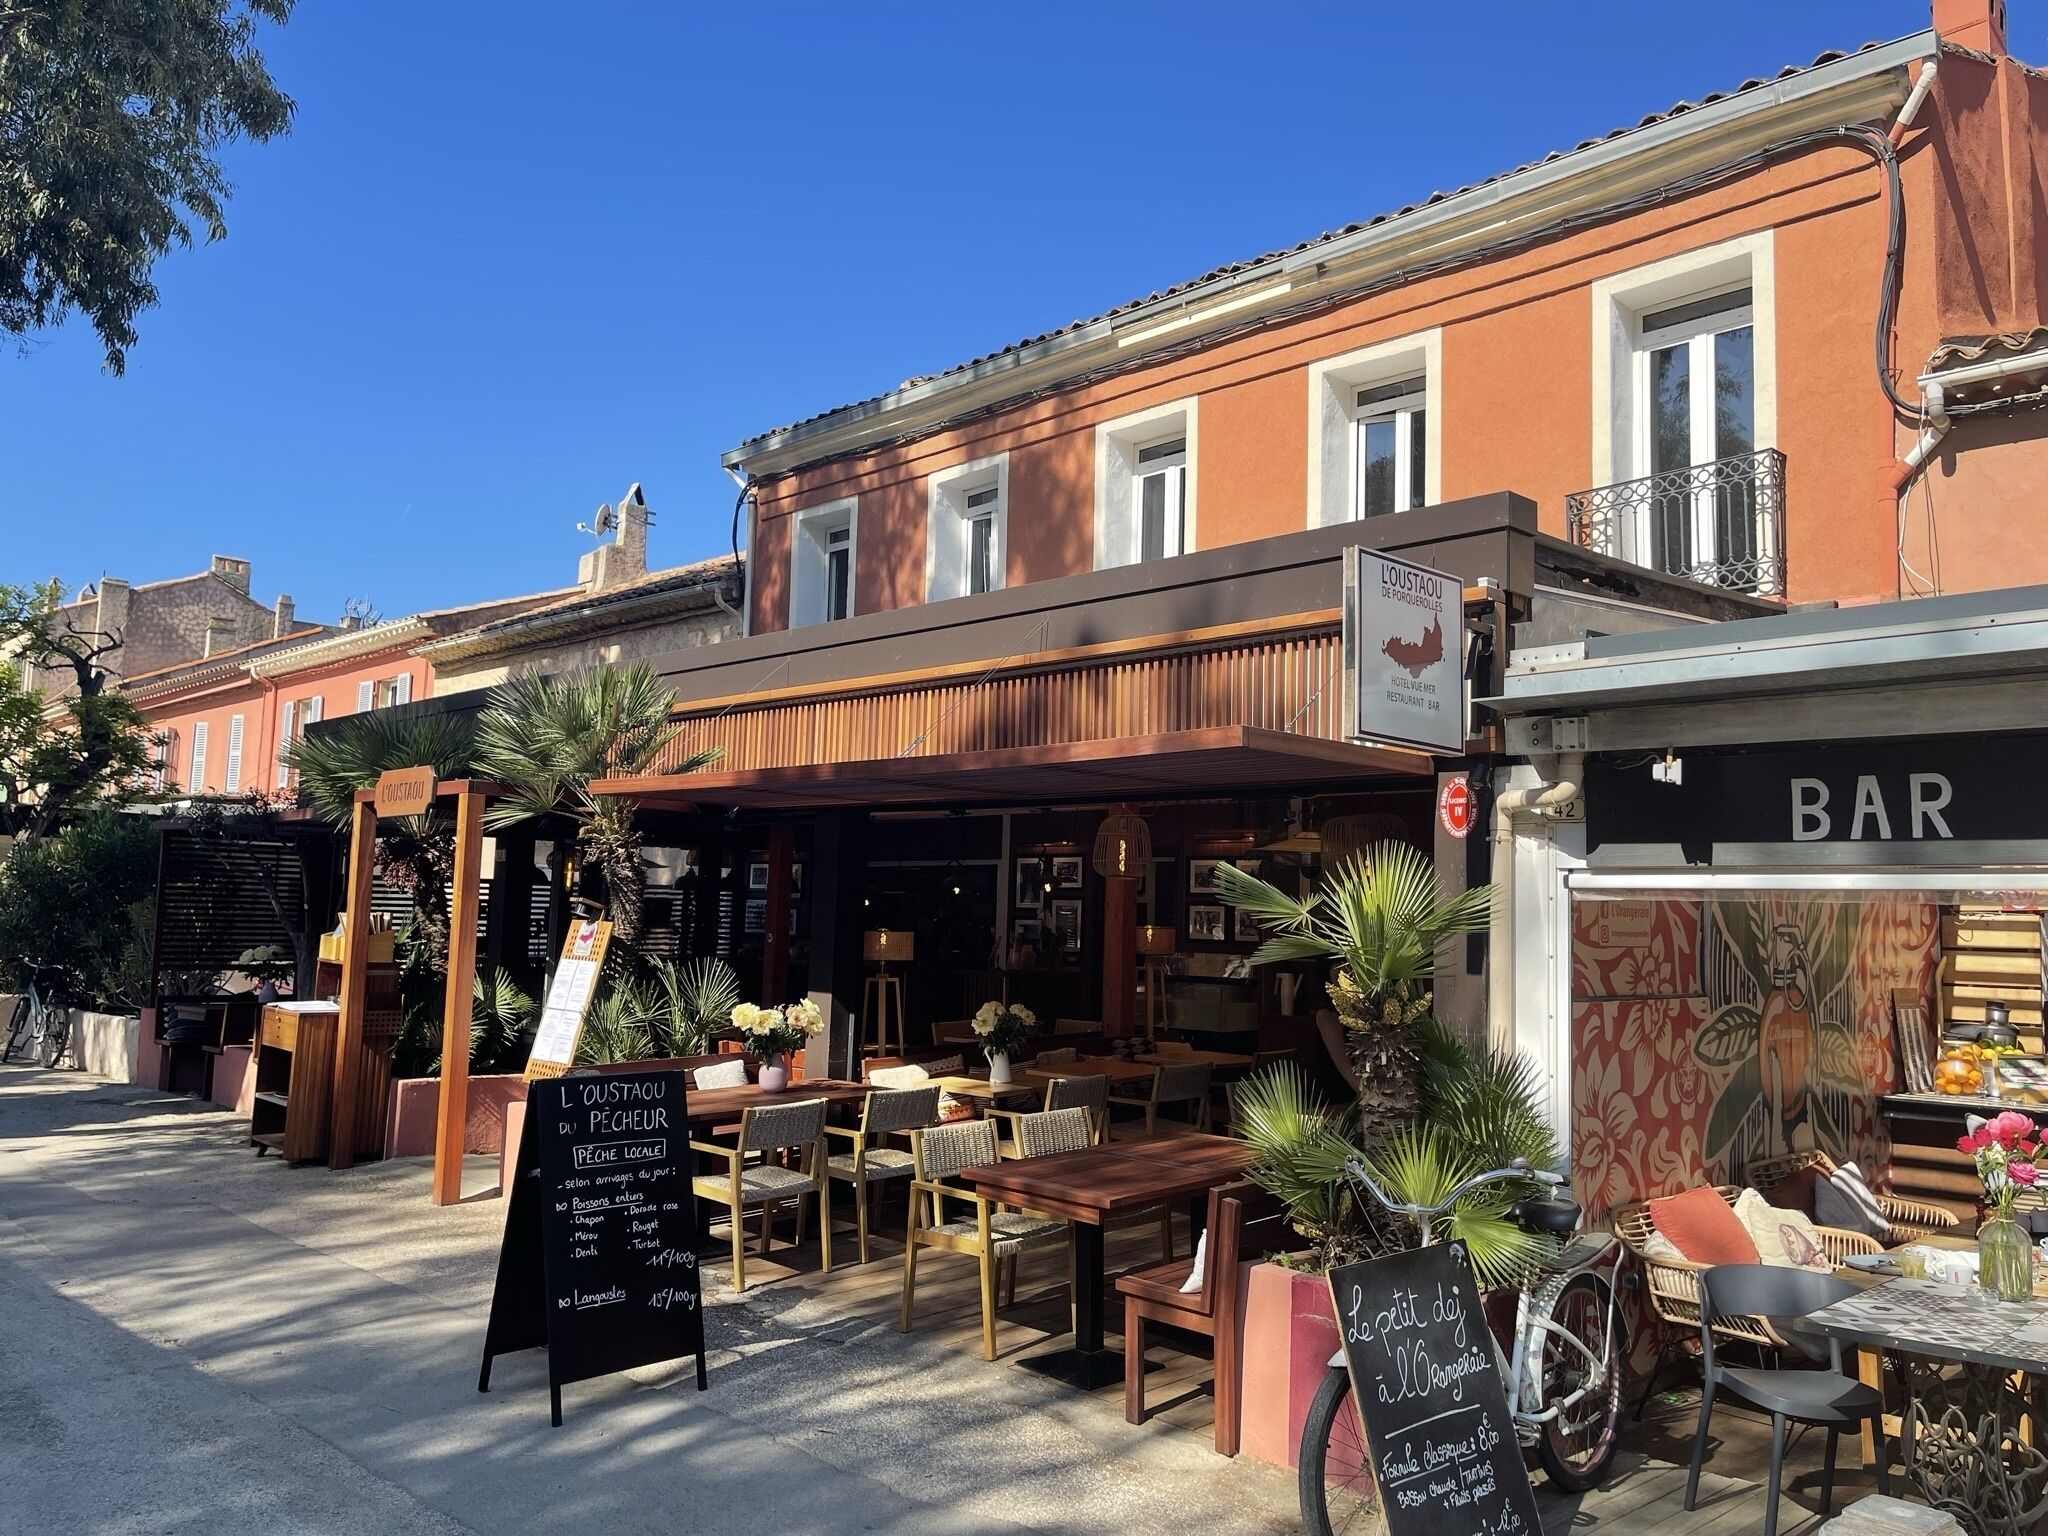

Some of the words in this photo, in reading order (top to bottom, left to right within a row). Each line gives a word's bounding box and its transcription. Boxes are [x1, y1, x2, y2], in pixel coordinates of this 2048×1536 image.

[1382, 563, 1442, 599] L'OUSTAOU
[1382, 586, 1391, 598] DE
[1393, 589, 1443, 612] PORQUEROLLES
[1391, 676, 1410, 689] HOTEL
[1411, 681, 1422, 692] VUE
[1424, 683, 1436, 694] MER
[1386, 690, 1424, 708] RESTAURANT
[1428, 700, 1440, 711] BAR
[381, 780, 425, 804] L'OUSTAOU
[1454, 806, 1463, 817] IV
[1554, 801, 1575, 818] 42
[1790, 772, 1954, 841] BAR
[561, 1081, 665, 1108] L'OUSTAOU
[559, 1122, 577, 1135] DU
[590, 1107, 669, 1133] PÊCHEUR
[578, 1146, 618, 1164] PÊCHE
[625, 1145, 662, 1158] LOCALE
[596, 1173, 634, 1189] arrivages
[638, 1169, 651, 1179] du
[572, 1197, 609, 1210] Poissons
[615, 1191, 644, 1203] entiers
[630, 1203, 657, 1215] Dorade
[663, 1202, 679, 1210] rose
[575, 1215, 605, 1227] Chapon
[632, 1219, 659, 1234] Rouget
[575, 1231, 598, 1241] Mérou
[632, 1238, 661, 1249] Turbot
[575, 1244, 598, 1258] Denti
[574, 1285, 627, 1307] Langoustes
[1348, 1284, 1375, 1343] Le
[1375, 1287, 1428, 1357] petit
[1383, 1442, 1421, 1480] Formule
